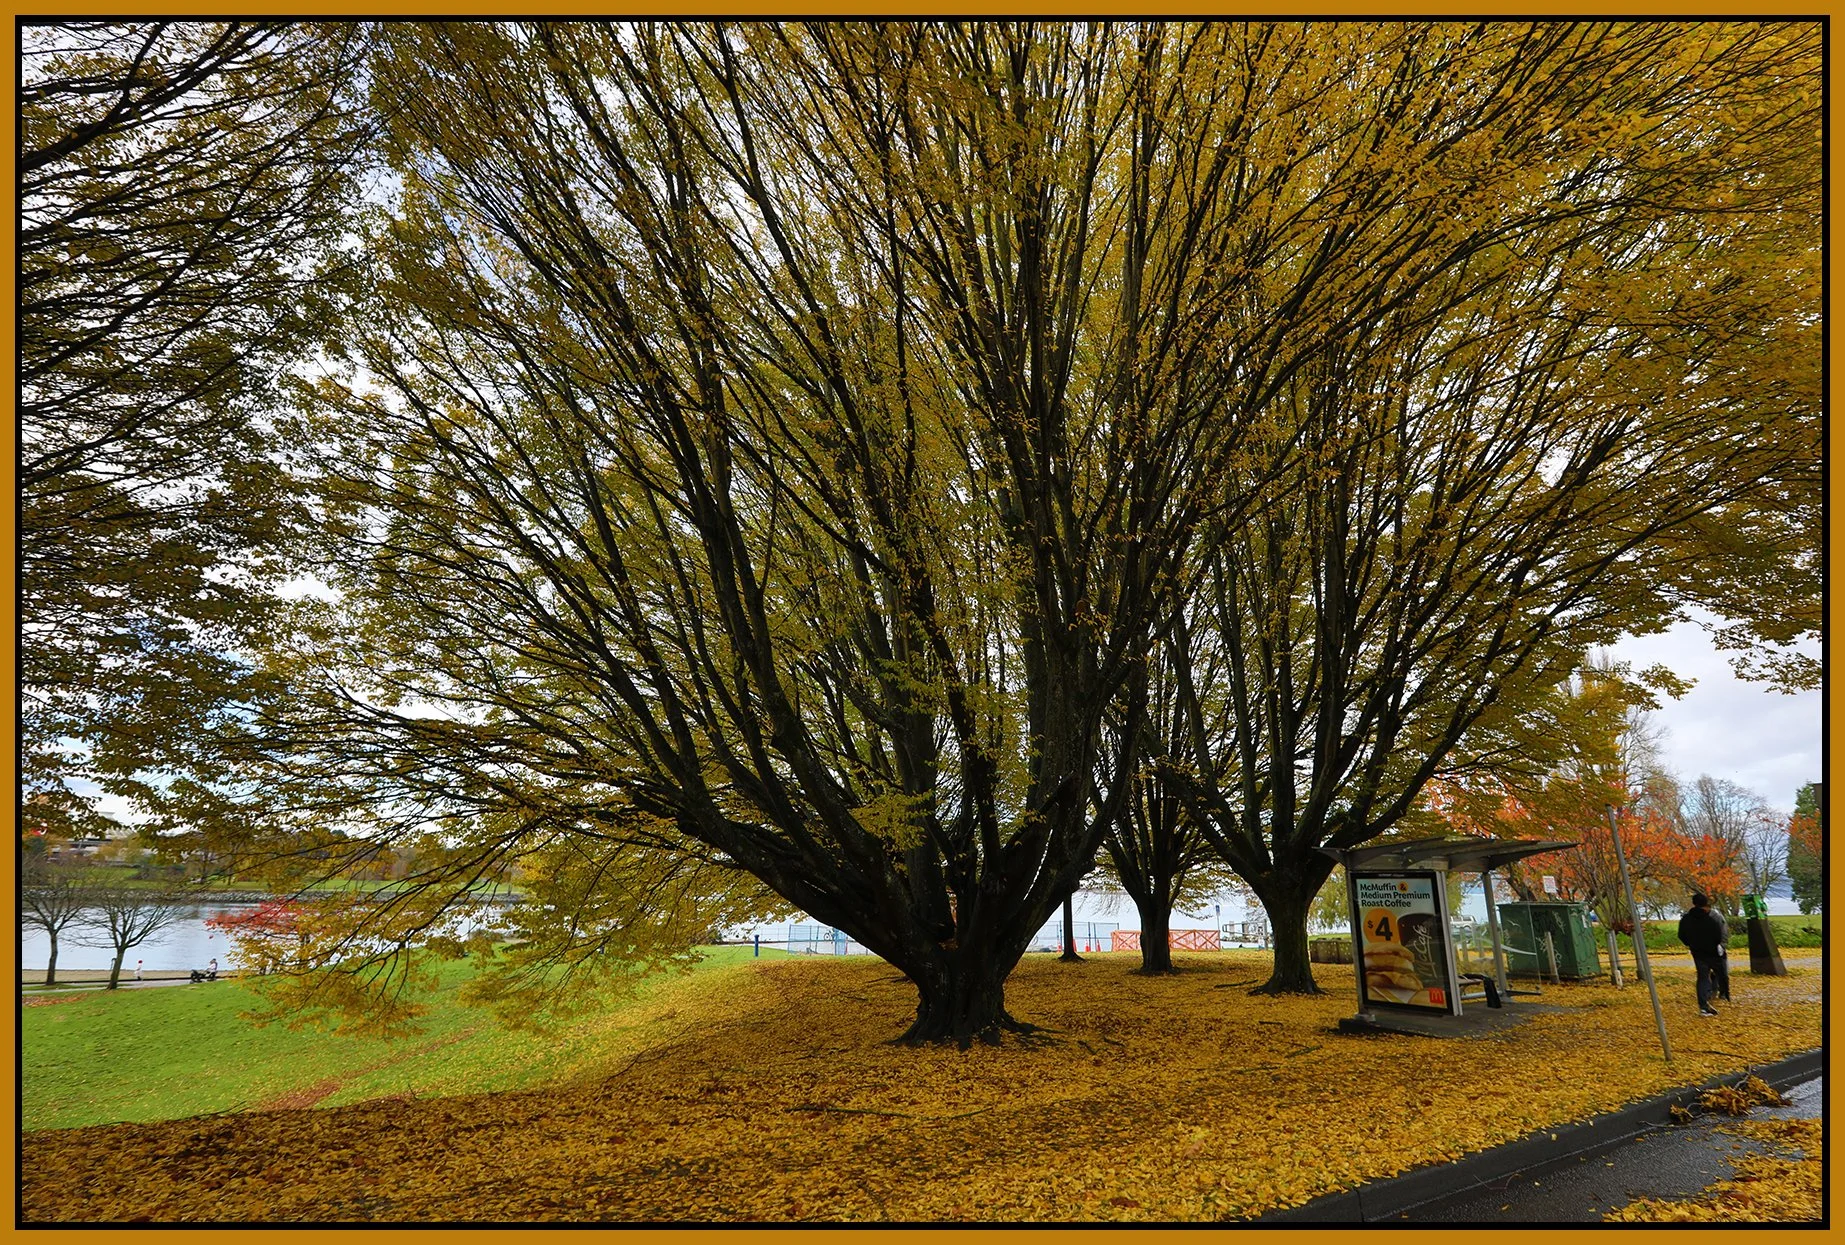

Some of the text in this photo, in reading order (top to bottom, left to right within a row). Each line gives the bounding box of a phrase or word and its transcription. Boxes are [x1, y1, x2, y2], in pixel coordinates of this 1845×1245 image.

[1360, 883, 1407, 891] McMuffin &
[1361, 891, 1431, 899] Medium Premium
[1361, 899, 1411, 907] Roast Coffee
[1368, 916, 1393, 941] $4
